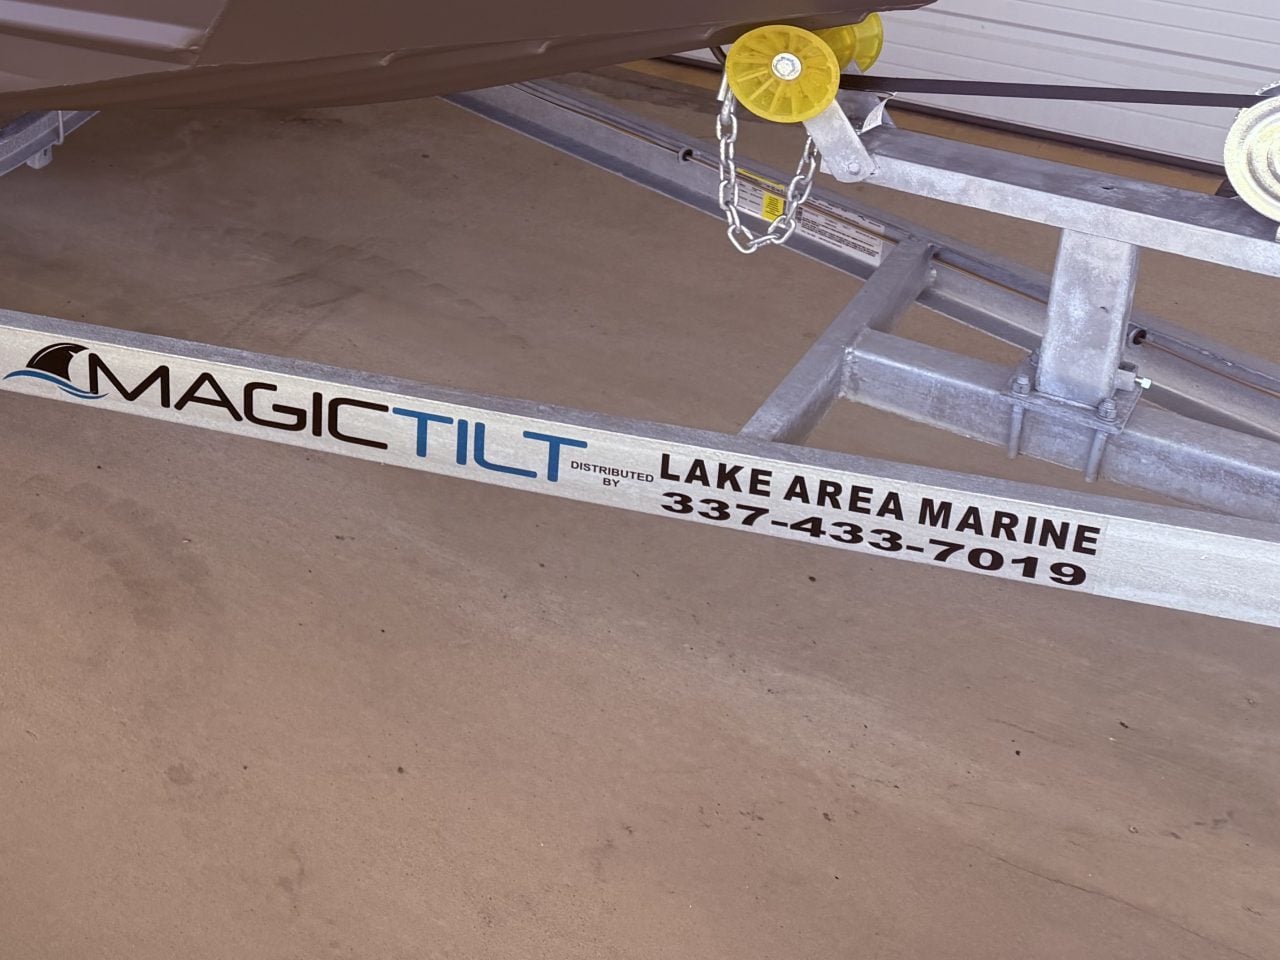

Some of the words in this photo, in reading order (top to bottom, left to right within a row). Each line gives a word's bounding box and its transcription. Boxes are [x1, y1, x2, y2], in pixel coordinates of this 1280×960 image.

[570, 460, 654, 483] DISTRIBUTED
[602, 477, 620, 487] BY
[660, 453, 773, 497] LAKE
[783, 475, 904, 521] AREA
[918, 497, 1101, 556] MARINE
[661, 492, 1086, 586] 337-433-7019
